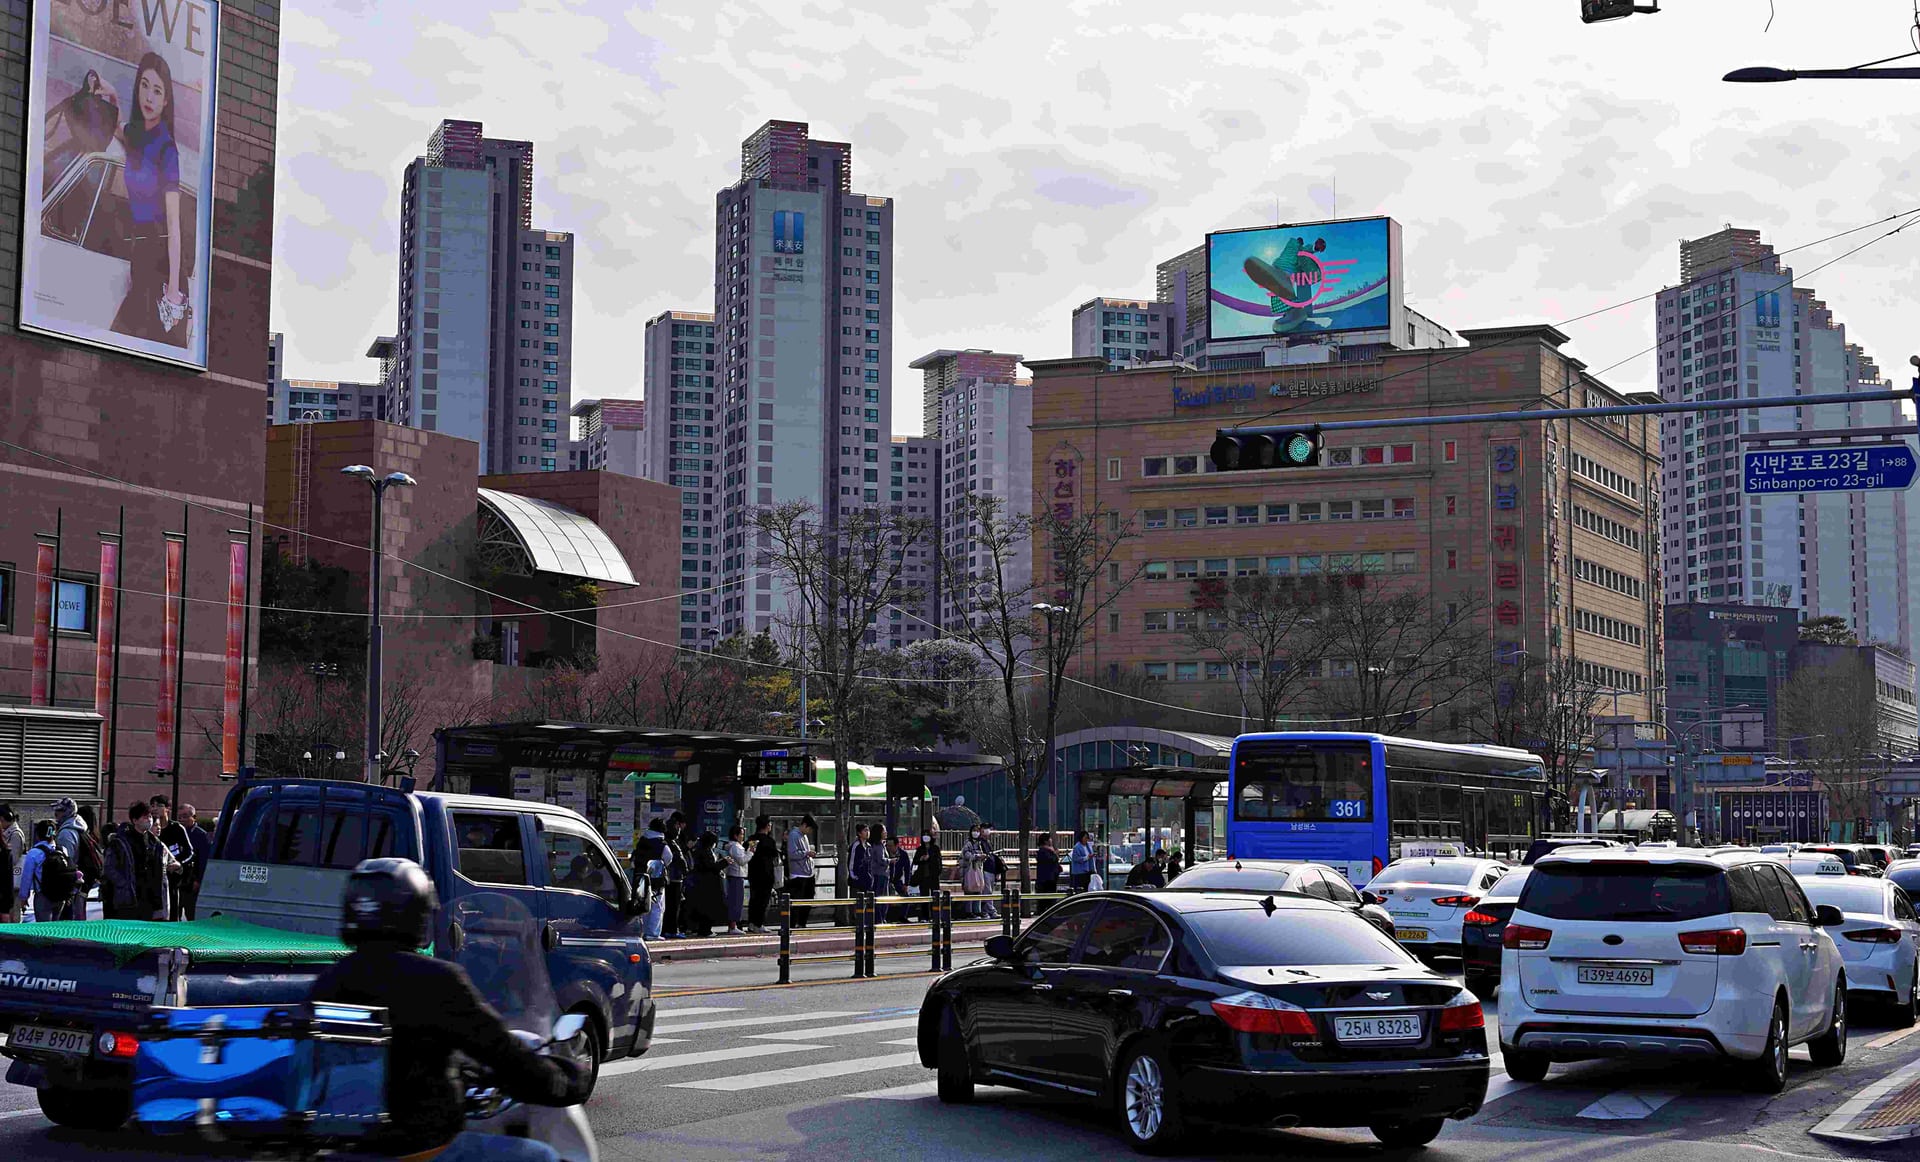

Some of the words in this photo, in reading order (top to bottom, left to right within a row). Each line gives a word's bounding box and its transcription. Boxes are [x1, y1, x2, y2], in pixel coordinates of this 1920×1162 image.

[48, 0, 206, 57] EWE
[1750, 451, 1869, 475] 신반포로23길
[1749, 476, 1839, 490] Sinbanpo-ro
[1842, 473, 1884, 488] 23-gil
[1335, 801, 1361, 817] 361
[0, 974, 77, 993] HYUNDAI
[1583, 969, 1614, 982] 139보
[1615, 971, 1648, 983] 4696
[1344, 1021, 1372, 1036] 25서
[1378, 1019, 1411, 1035] 8328
[16, 1027, 44, 1044] 84부
[49, 1032, 84, 1050] 8901
